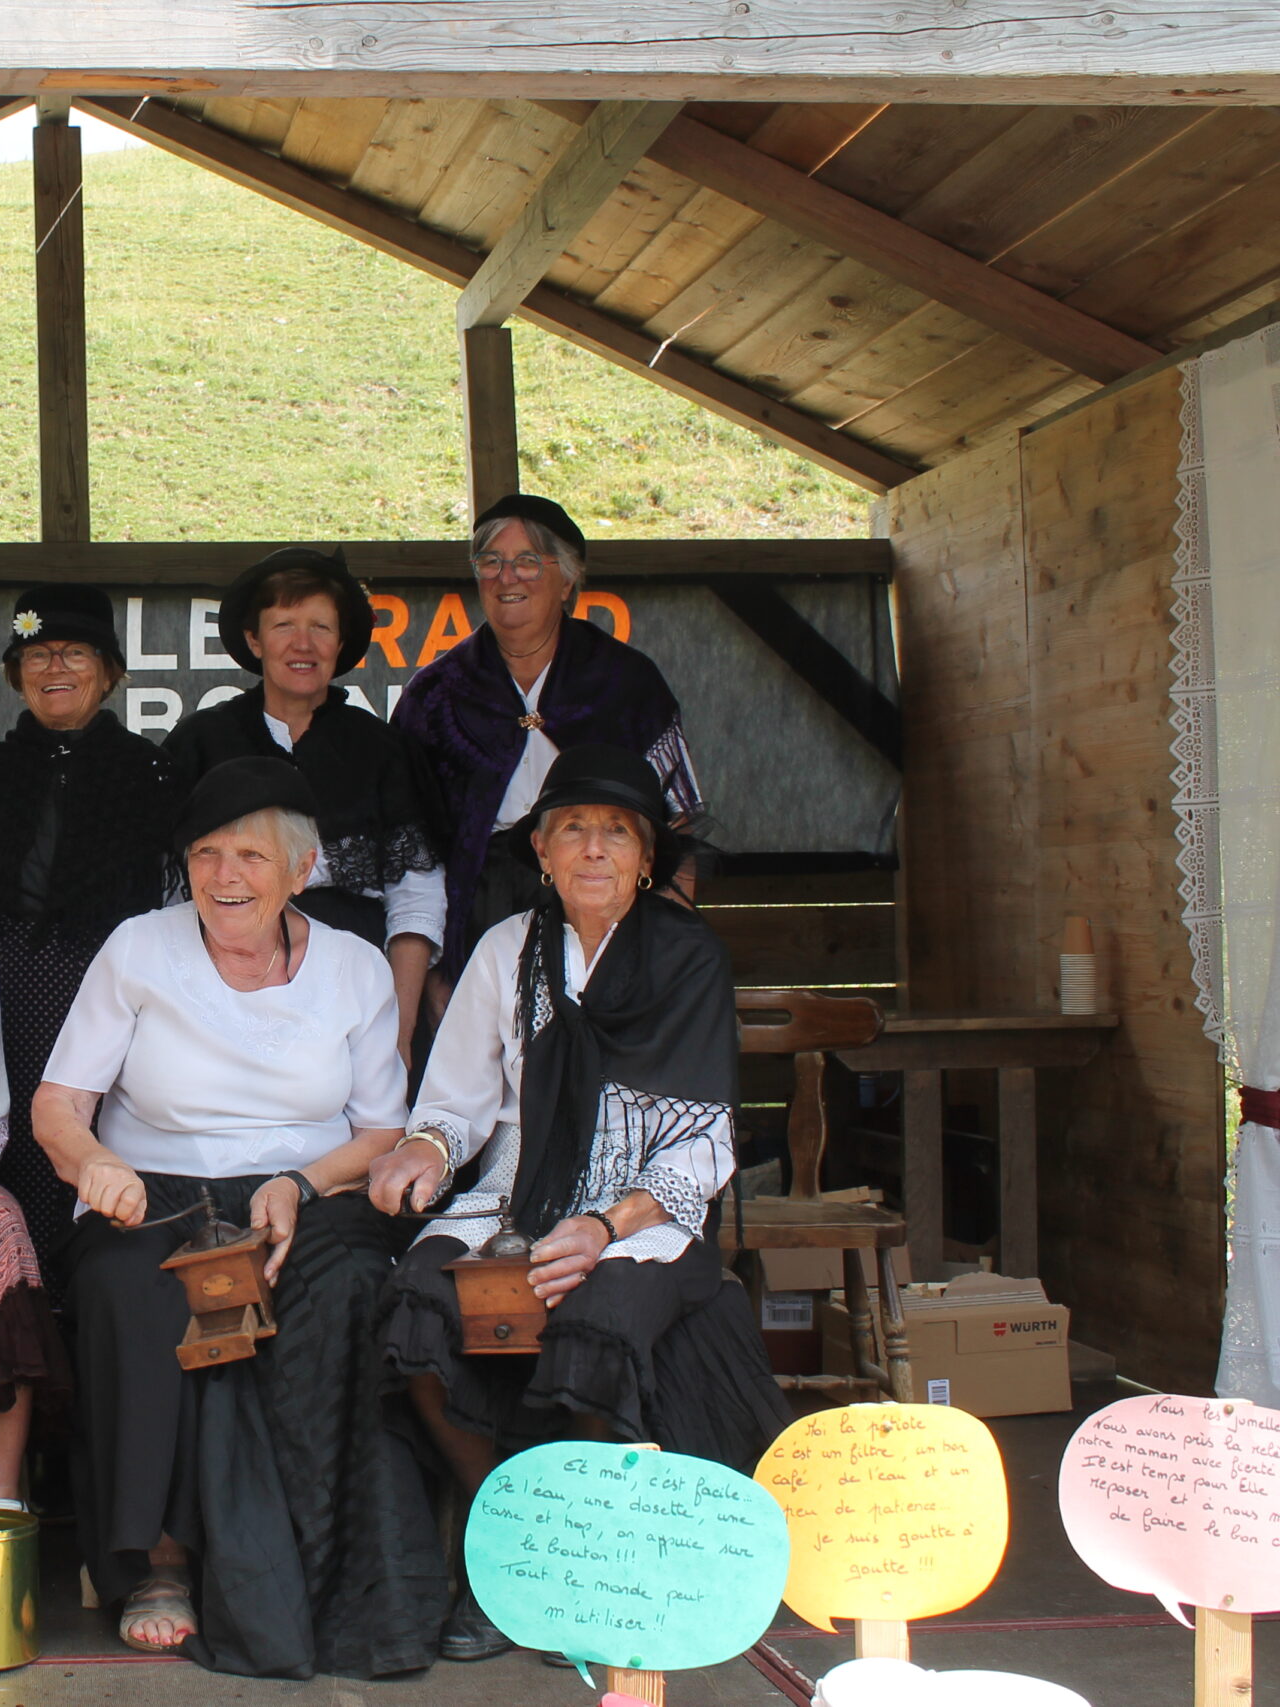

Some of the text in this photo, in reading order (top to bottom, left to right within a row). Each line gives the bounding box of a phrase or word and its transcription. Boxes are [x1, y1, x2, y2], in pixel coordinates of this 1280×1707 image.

[127, 591, 631, 669] LE RAD
[1010, 1319, 1057, 1333] WÜRTH
[840, 1412, 856, 1433] la
[1149, 1396, 1184, 1416] Nous
[1203, 1402, 1221, 1421] les
[1093, 1415, 1127, 1434] Nous
[1136, 1428, 1176, 1441] avons
[1183, 1432, 1214, 1450] pris
[1224, 1434, 1242, 1452] la
[822, 1450, 842, 1459] un
[916, 1446, 936, 1455] un
[943, 1439, 969, 1452] bon
[1078, 1434, 1114, 1449] notre
[1125, 1444, 1178, 1462] maman
[1192, 1457, 1222, 1468] avec
[563, 1459, 588, 1474] Et
[838, 1472, 861, 1486] de
[924, 1466, 938, 1478] et
[950, 1468, 970, 1476] un
[1111, 1459, 1133, 1473] est
[1141, 1462, 1186, 1491] temps
[1194, 1477, 1228, 1494] pour
[494, 1475, 515, 1495] De
[584, 1497, 614, 1509] une
[717, 1513, 755, 1526] une
[783, 1503, 818, 1525] peu
[835, 1499, 855, 1515] de
[1090, 1478, 1149, 1500] reposer
[1170, 1493, 1188, 1505] et
[1202, 1497, 1214, 1511] à
[1223, 1506, 1258, 1520] nous
[482, 1500, 524, 1521] tasse
[535, 1510, 551, 1524] et
[617, 1530, 635, 1538] on
[646, 1533, 704, 1559] appuie
[719, 1544, 754, 1558] sur
[845, 1532, 880, 1544] suis
[899, 1524, 956, 1549] goutte
[963, 1522, 974, 1536] à
[1110, 1505, 1131, 1521] de
[1143, 1507, 1187, 1532] faire
[1204, 1520, 1221, 1537] le
[1231, 1524, 1258, 1543] bon
[520, 1533, 539, 1552] le
[547, 1537, 608, 1561] bouton
[500, 1560, 704, 1607] Tout le monde peut
[844, 1558, 909, 1582] goutte
